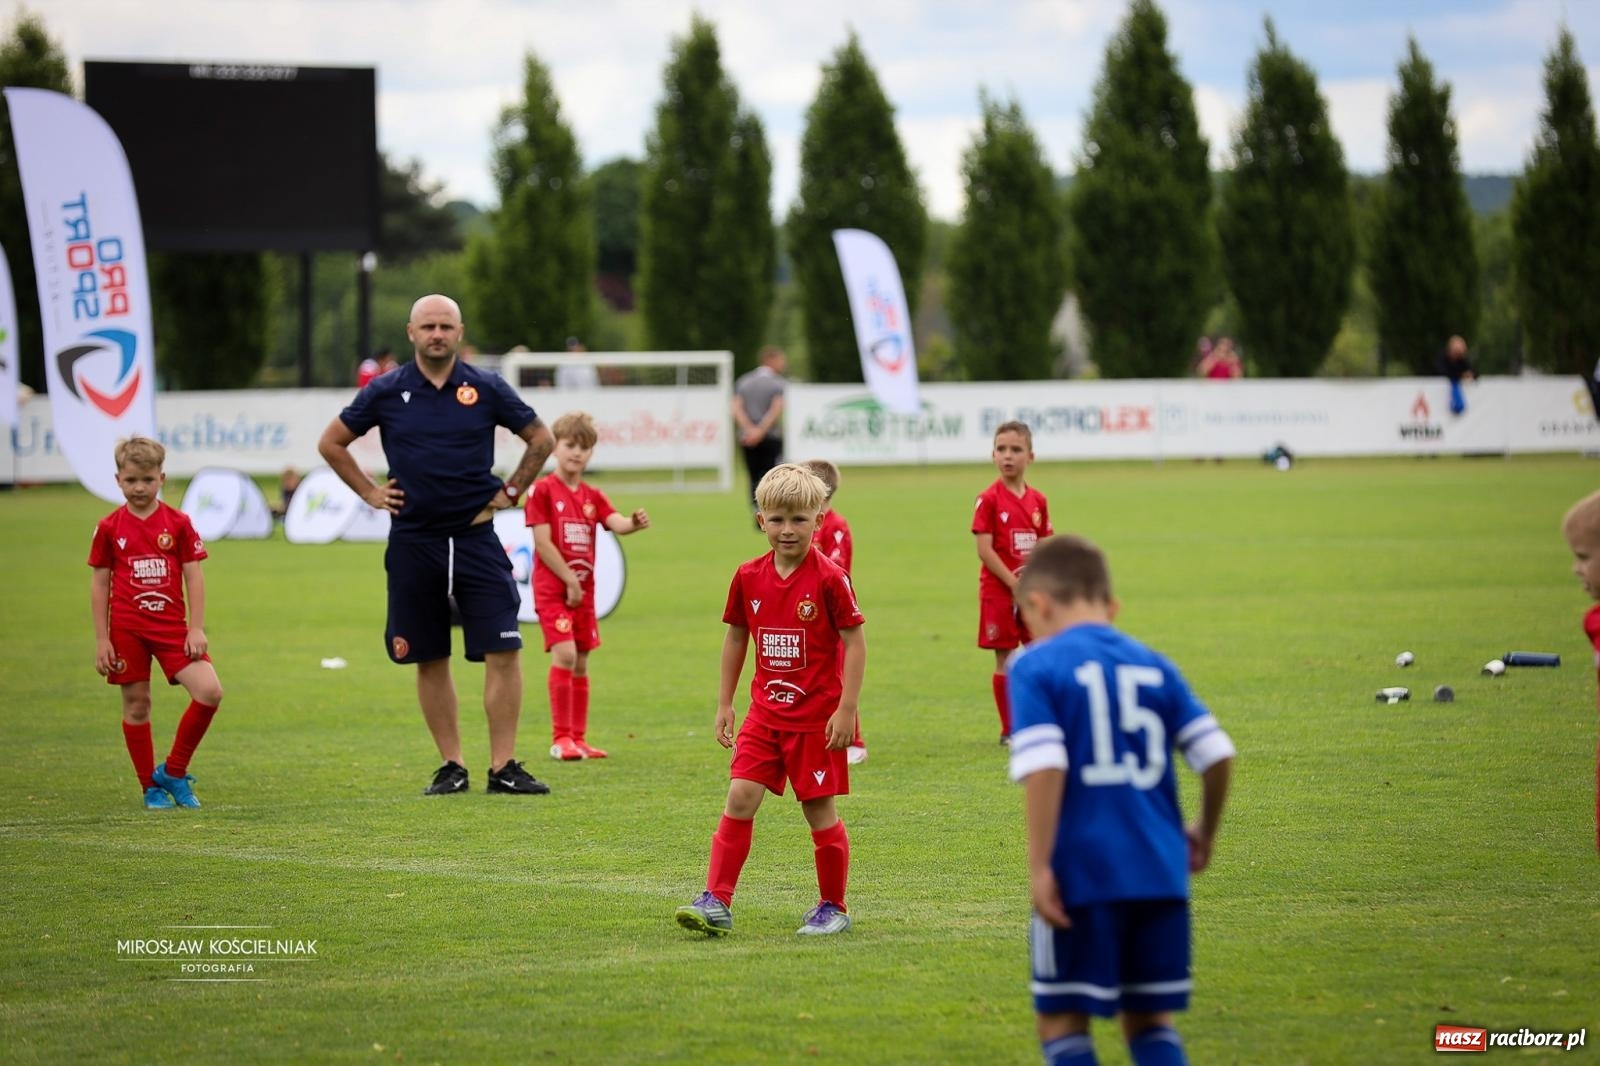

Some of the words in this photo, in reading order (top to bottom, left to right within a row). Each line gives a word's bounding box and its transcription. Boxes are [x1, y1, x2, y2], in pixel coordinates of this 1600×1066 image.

[762, 633, 800, 647] SAFETY
[762, 645, 800, 658] JOGGER
[769, 659, 791, 667] WORKS
[1074, 660, 1167, 791] 15
